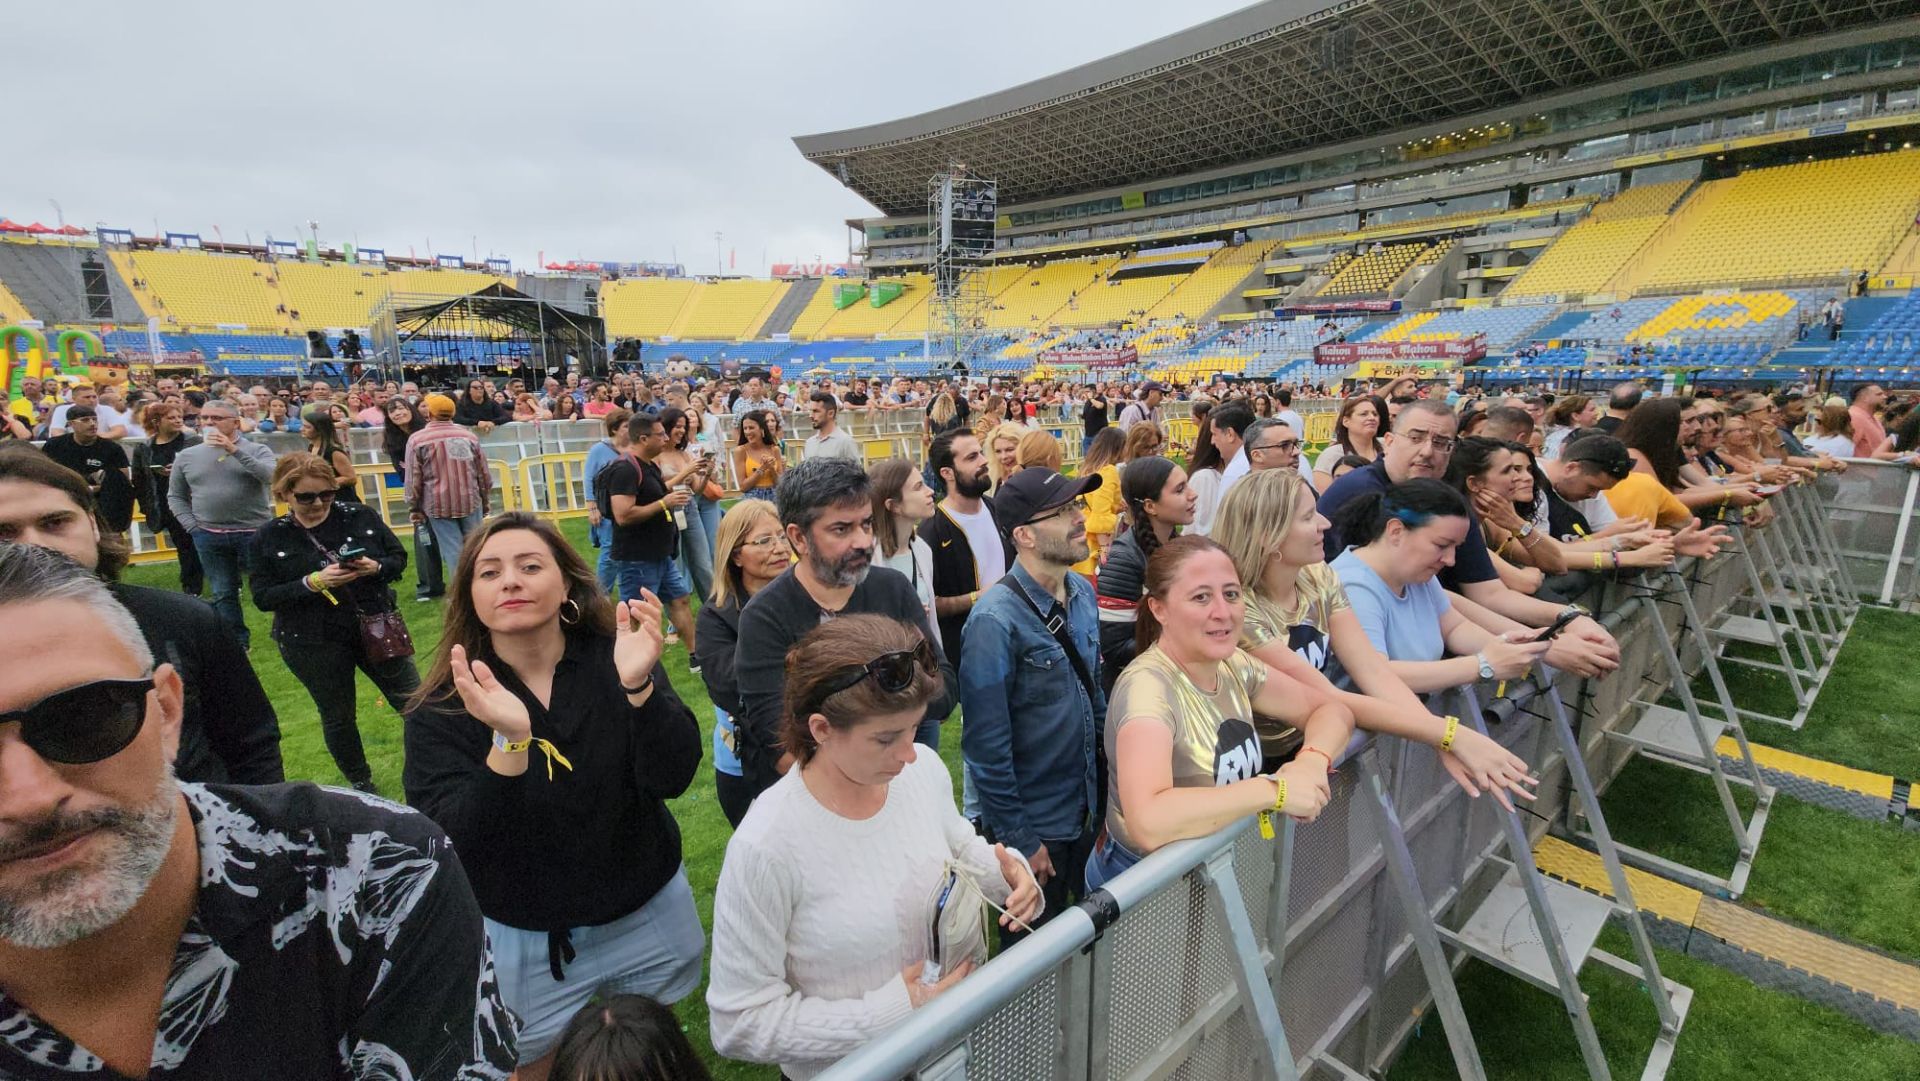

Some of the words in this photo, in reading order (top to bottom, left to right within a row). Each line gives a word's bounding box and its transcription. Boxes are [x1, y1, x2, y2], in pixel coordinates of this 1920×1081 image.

[1319, 345, 1351, 355] Mahou
[1357, 345, 1393, 355] Mahou
[1399, 343, 1437, 354] Mahou
[1385, 363, 1427, 376] BAS
